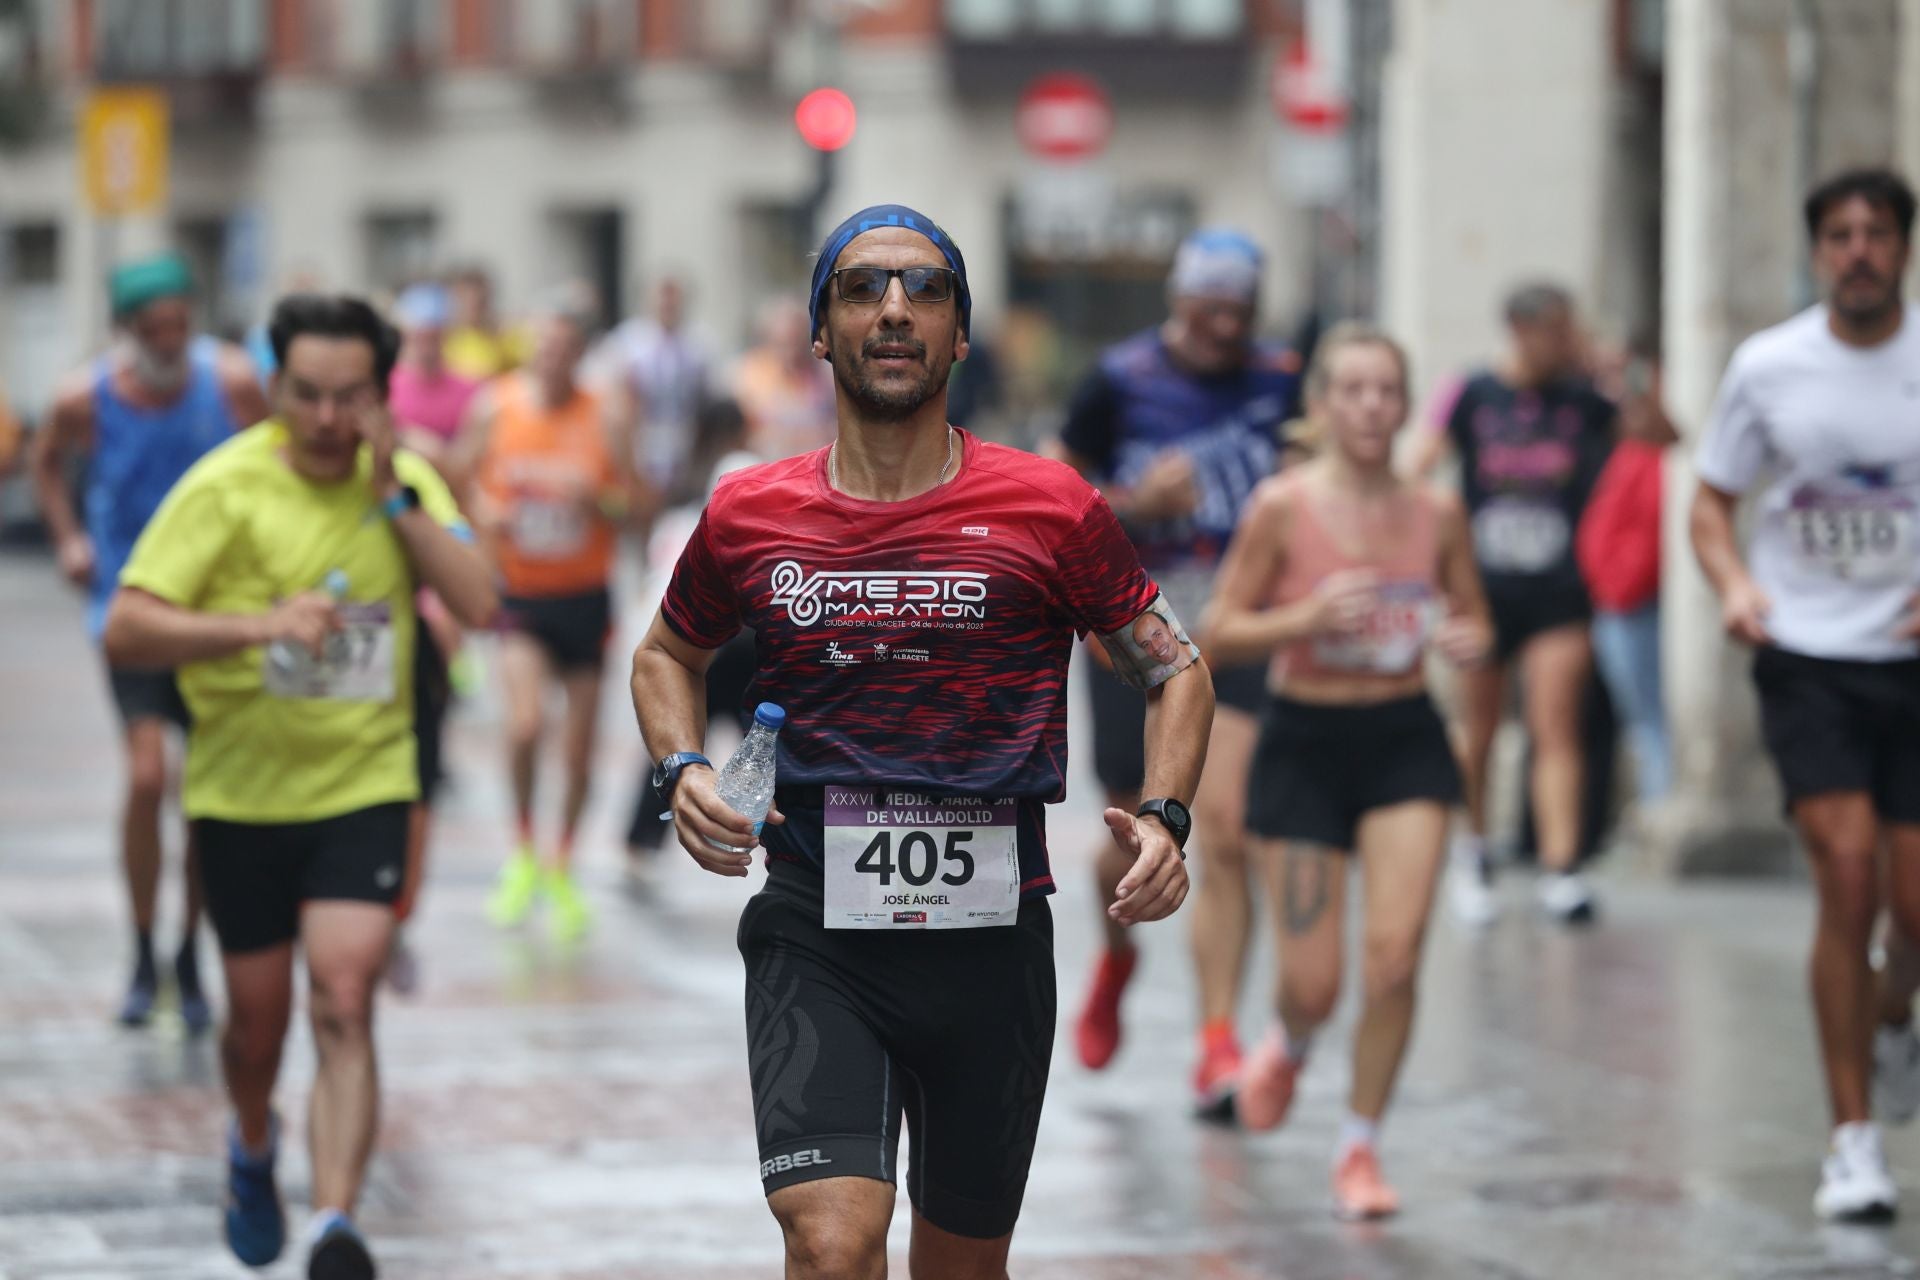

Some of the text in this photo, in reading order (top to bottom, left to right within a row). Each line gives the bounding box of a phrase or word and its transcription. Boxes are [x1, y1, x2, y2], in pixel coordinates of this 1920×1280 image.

[825, 579, 987, 602] MEDIO
[824, 619, 853, 627] CIUDAD
[868, 619, 907, 628] ALBACETE
[911, 620, 921, 628] 04
[922, 620, 932, 628] de
[934, 620, 954, 629] Junio
[955, 621, 965, 629] de
[966, 620, 984, 630] 2023
[893, 654, 929, 662] ALBACETE
[829, 792, 873, 806] XXXVI
[866, 810, 993, 825] DE VALLADOLID
[854, 830, 975, 887] 405
[882, 893, 951, 905] JOSÉ ÁNGEL
